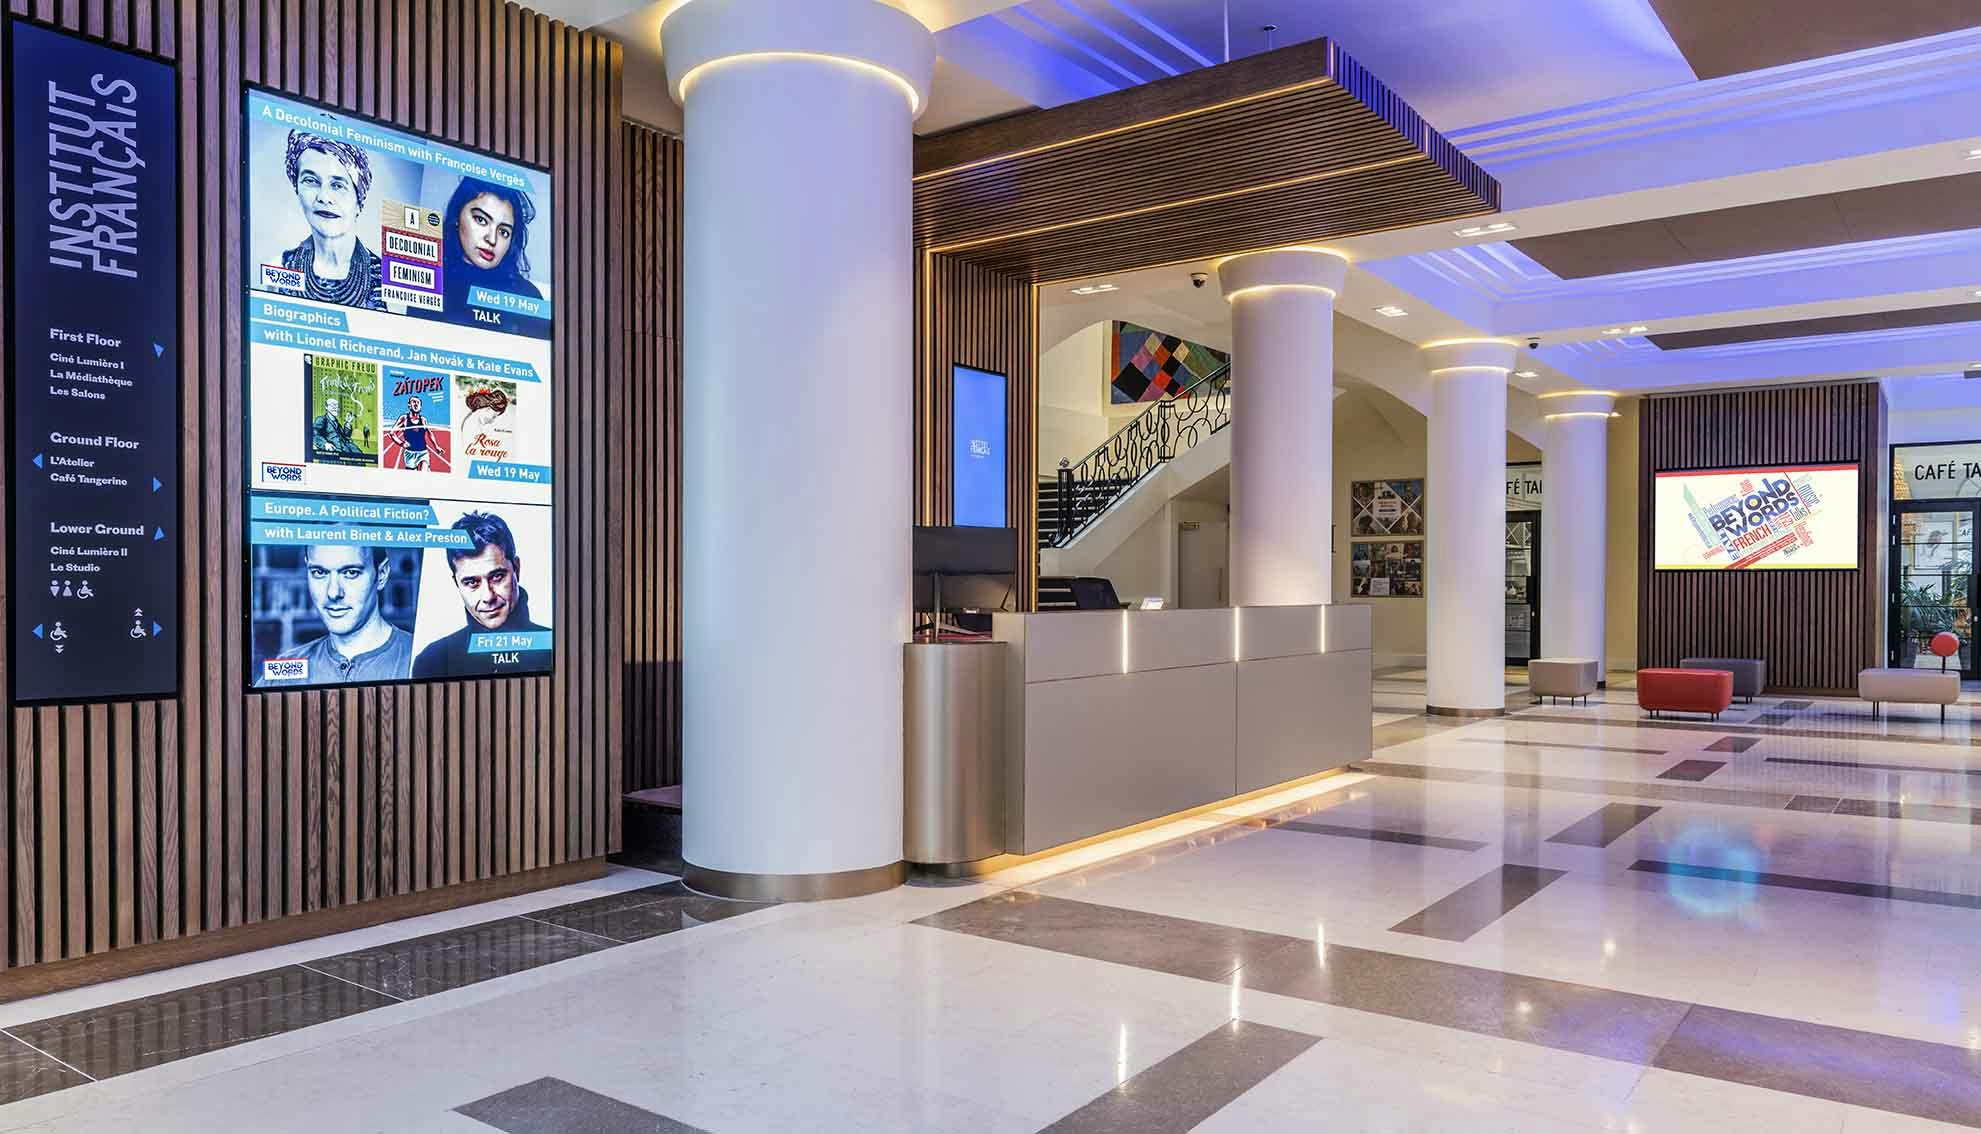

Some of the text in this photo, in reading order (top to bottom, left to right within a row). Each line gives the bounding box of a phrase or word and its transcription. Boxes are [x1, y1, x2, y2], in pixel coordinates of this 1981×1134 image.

[262, 104, 272, 118] A
[275, 108, 343, 138] Decolonial
[346, 127, 405, 153] Feminism
[407, 146, 432, 161] with
[435, 152, 487, 177] Françoise
[48, 80, 97, 269] INSTITUT
[91, 73, 146, 278] FRANÇAIS
[410, 212, 415, 225] A
[389, 236, 435, 258] DECOLONIAL
[265, 268, 301, 281] BEYOND
[270, 276, 300, 287] WORDS
[393, 265, 432, 285] FEMINISM
[476, 290, 540, 314] Wed 19 May
[263, 304, 341, 327] Biographics
[472, 309, 501, 324] TALK
[50, 328, 121, 347] First Floor
[50, 352, 74, 364] Ciné
[77, 356, 119, 369] Lumière
[264, 329, 533, 377] with Lionel Richerand, Jan Novák & Kate Evans
[315, 357, 376, 373] GRAPHIC FREUD
[50, 369, 133, 387] La Médiathèque
[393, 376, 444, 396] ZÁTOPEK
[50, 386, 106, 400] Les Salons
[50, 432, 139, 449] Ground Floor
[474, 433, 501, 448] Rosa
[465, 443, 508, 463] la rouge
[266, 466, 302, 475] BEYOND
[271, 473, 302, 481] WORDS
[477, 464, 540, 481] Wed 19 May
[1915, 461, 1956, 481] CAFÉ
[50, 473, 128, 486] Café Tangerine
[1524, 480, 1542, 495] TA
[265, 502, 430, 520] Europe. A Political Fiction?
[1709, 478, 1790, 531] BEYOND
[1725, 492, 1799, 536] WORDS
[50, 522, 144, 536] Lower Ground
[264, 528, 467, 544] with Laurent Binet & Alex Preston
[1733, 523, 1772, 551] FRENCH
[50, 547, 75, 555] Ciné
[77, 547, 119, 557] Lumière
[50, 563, 100, 572] Le Studio
[478, 636, 533, 649] Fri 21 May
[268, 662, 304, 670] BEYOND
[491, 652, 520, 664] TALK
